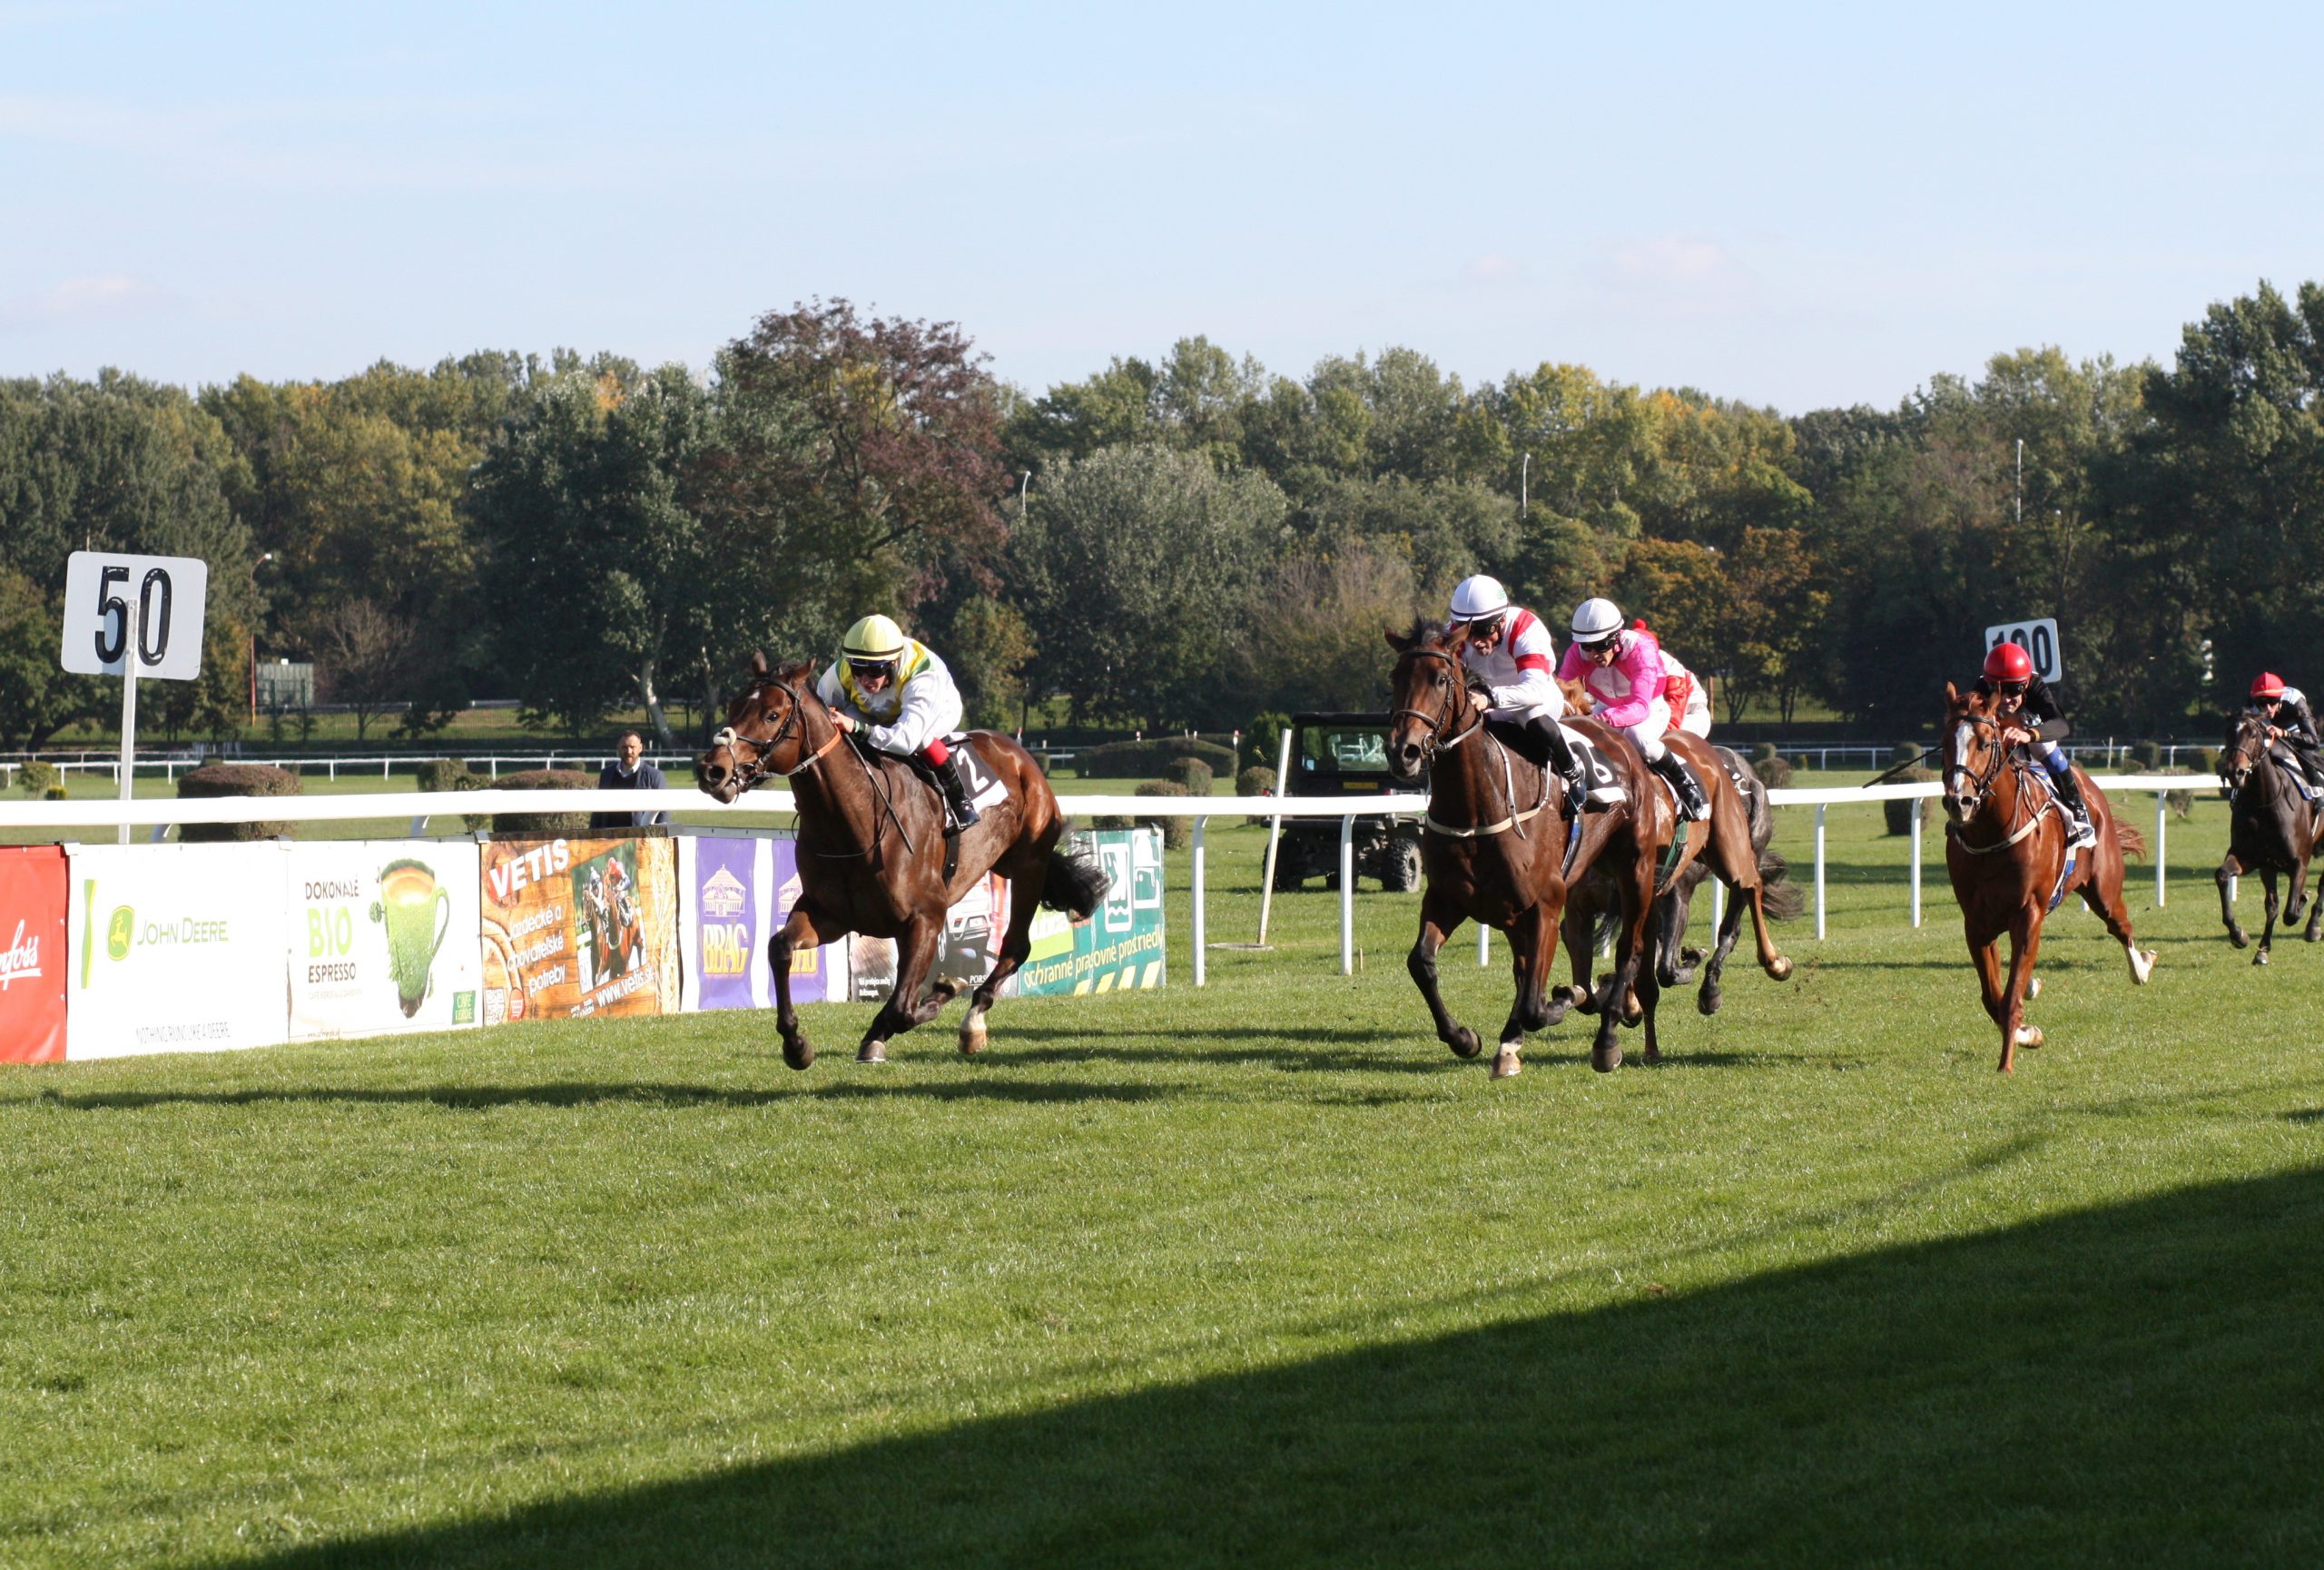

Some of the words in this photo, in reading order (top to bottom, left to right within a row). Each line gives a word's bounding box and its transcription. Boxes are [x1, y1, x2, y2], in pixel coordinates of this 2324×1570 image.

[94, 565, 172, 667] 50
[956, 747, 990, 793] 2
[488, 838, 570, 899] VETIS
[136, 919, 178, 946] JOHN
[181, 916, 229, 944] DEERE
[307, 905, 353, 958] BIO
[703, 923, 749, 973] BBAG
[308, 963, 357, 983] ESPRESSO
[528, 963, 566, 998] potreby
[1023, 953, 1073, 989] ochranné
[1075, 938, 1117, 981] pracovné
